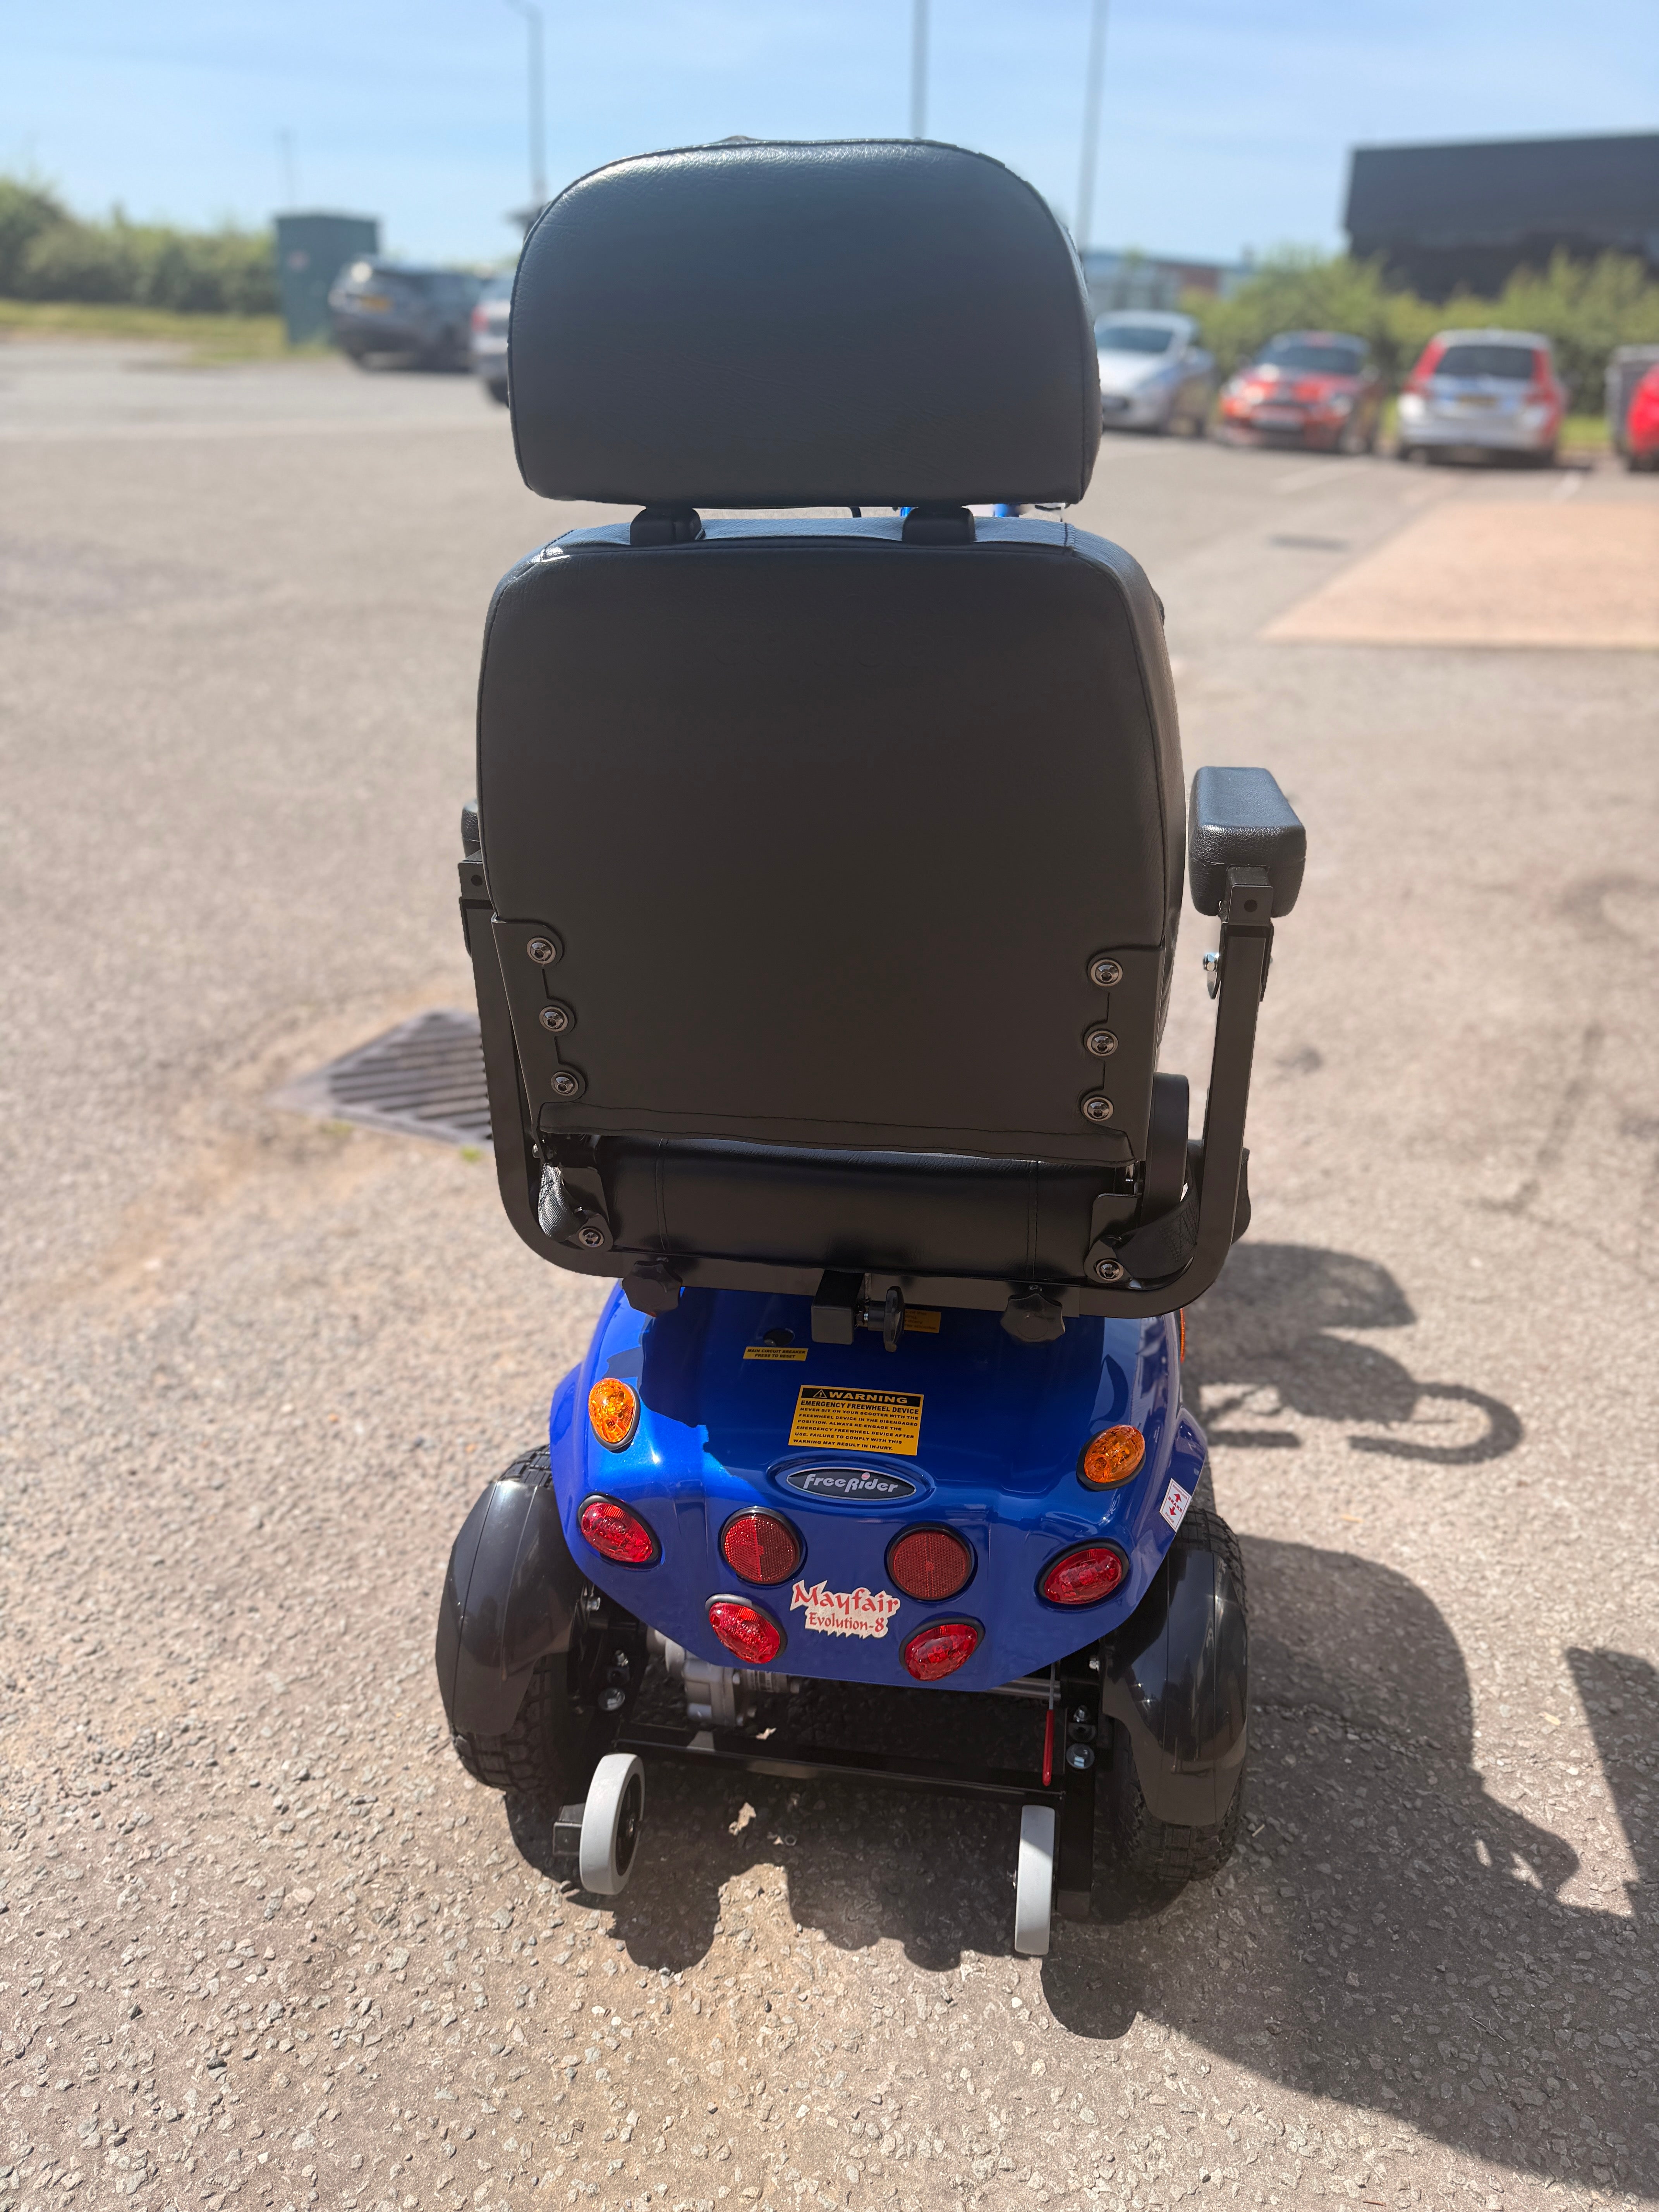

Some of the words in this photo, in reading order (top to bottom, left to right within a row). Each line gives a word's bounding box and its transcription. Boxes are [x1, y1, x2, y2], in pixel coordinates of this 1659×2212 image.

[829, 1391, 907, 1403] WARNING
[847, 1403, 890, 1412] FREEWHEEL
[1168, 1496, 1183, 1513] BRAKE
[795, 1584, 898, 1615] Mayfair
[809, 1612, 884, 1632] Evolution-8
